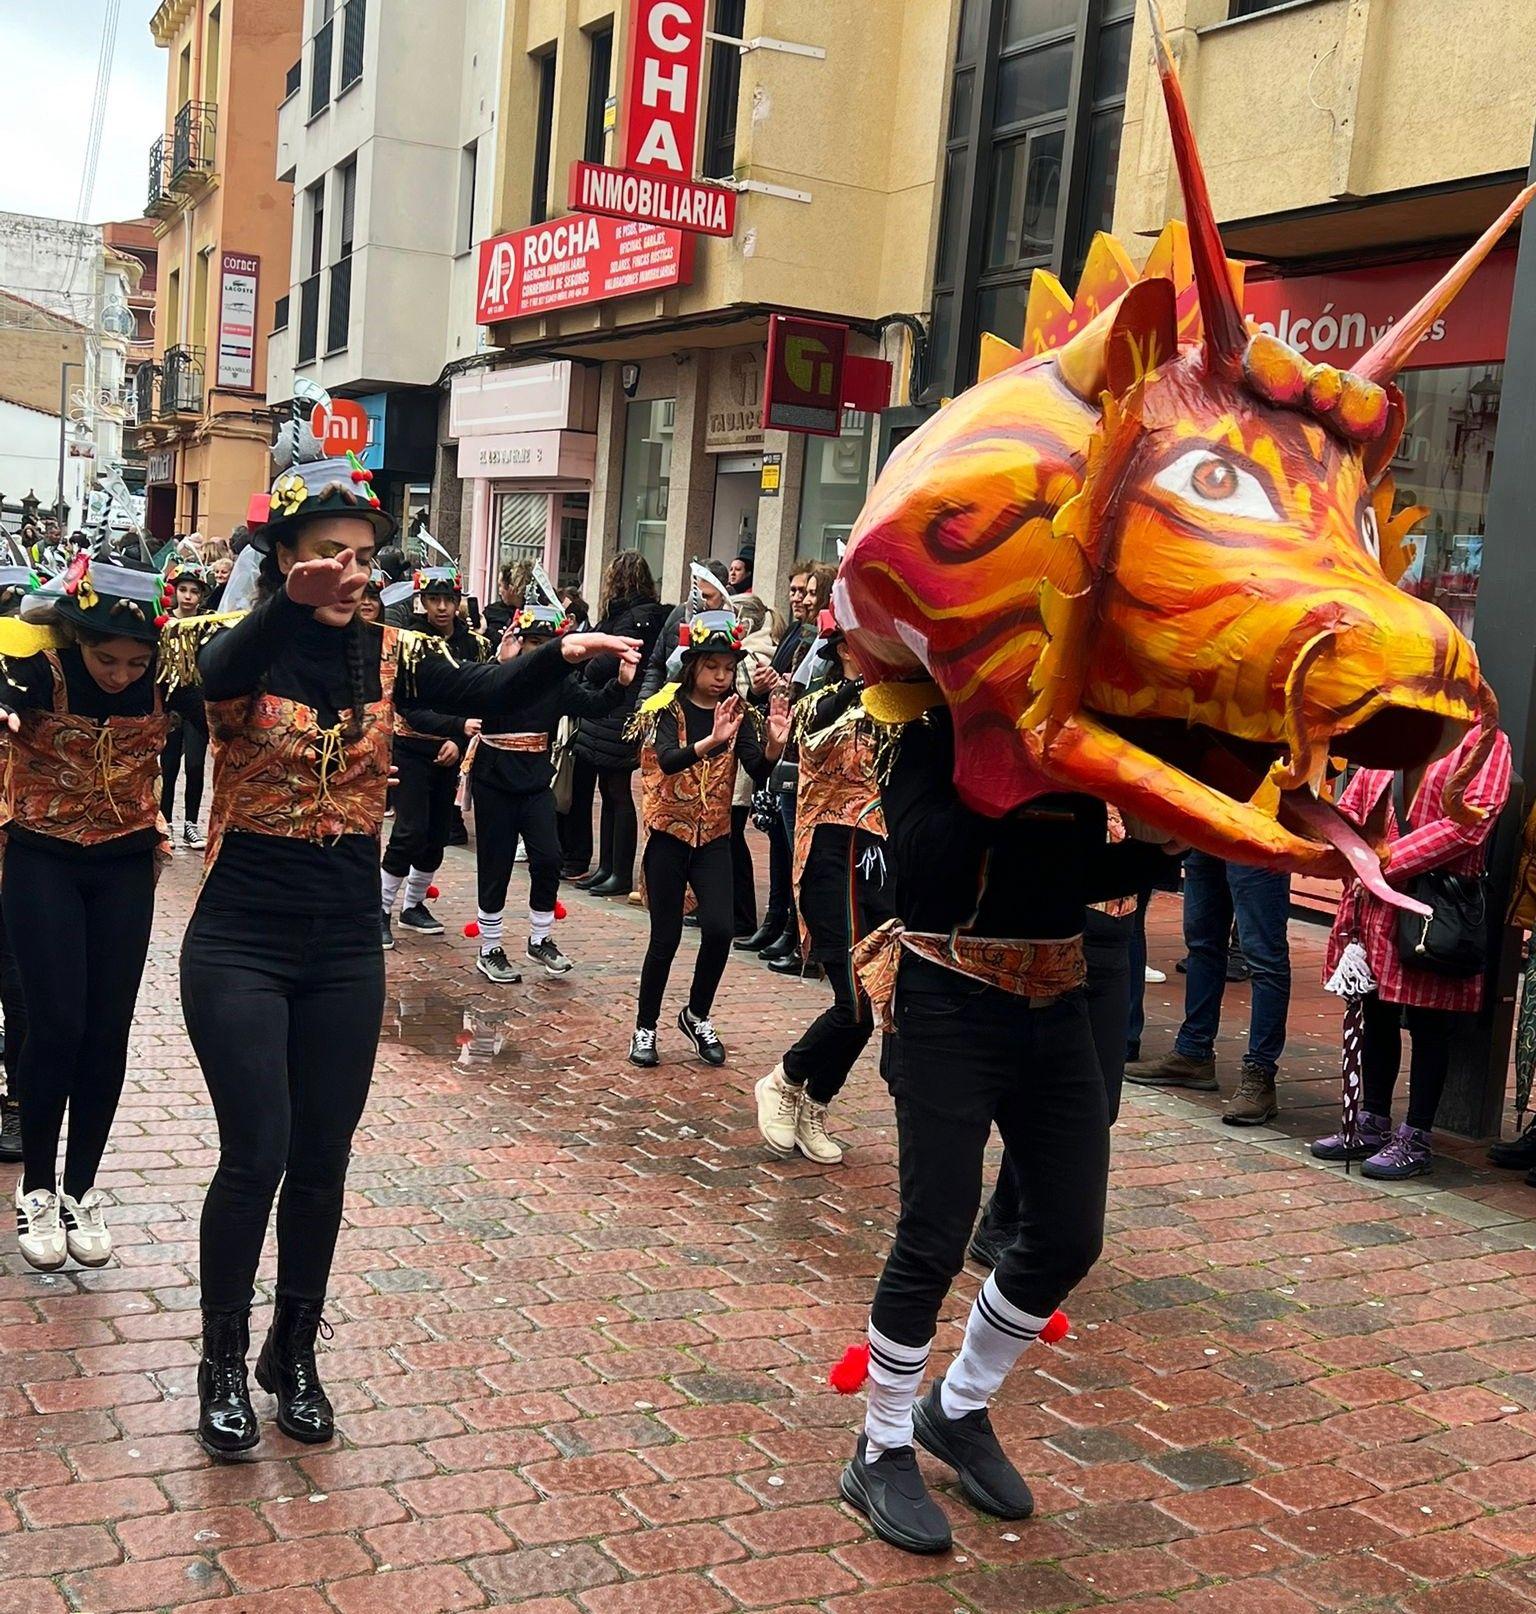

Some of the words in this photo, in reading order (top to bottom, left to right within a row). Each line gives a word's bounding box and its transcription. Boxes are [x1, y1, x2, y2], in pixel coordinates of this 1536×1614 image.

[582, 168, 727, 230] INMOBILIARIA
[523, 216, 601, 268] ROCHA
[225, 285, 253, 295] LACOSTE
